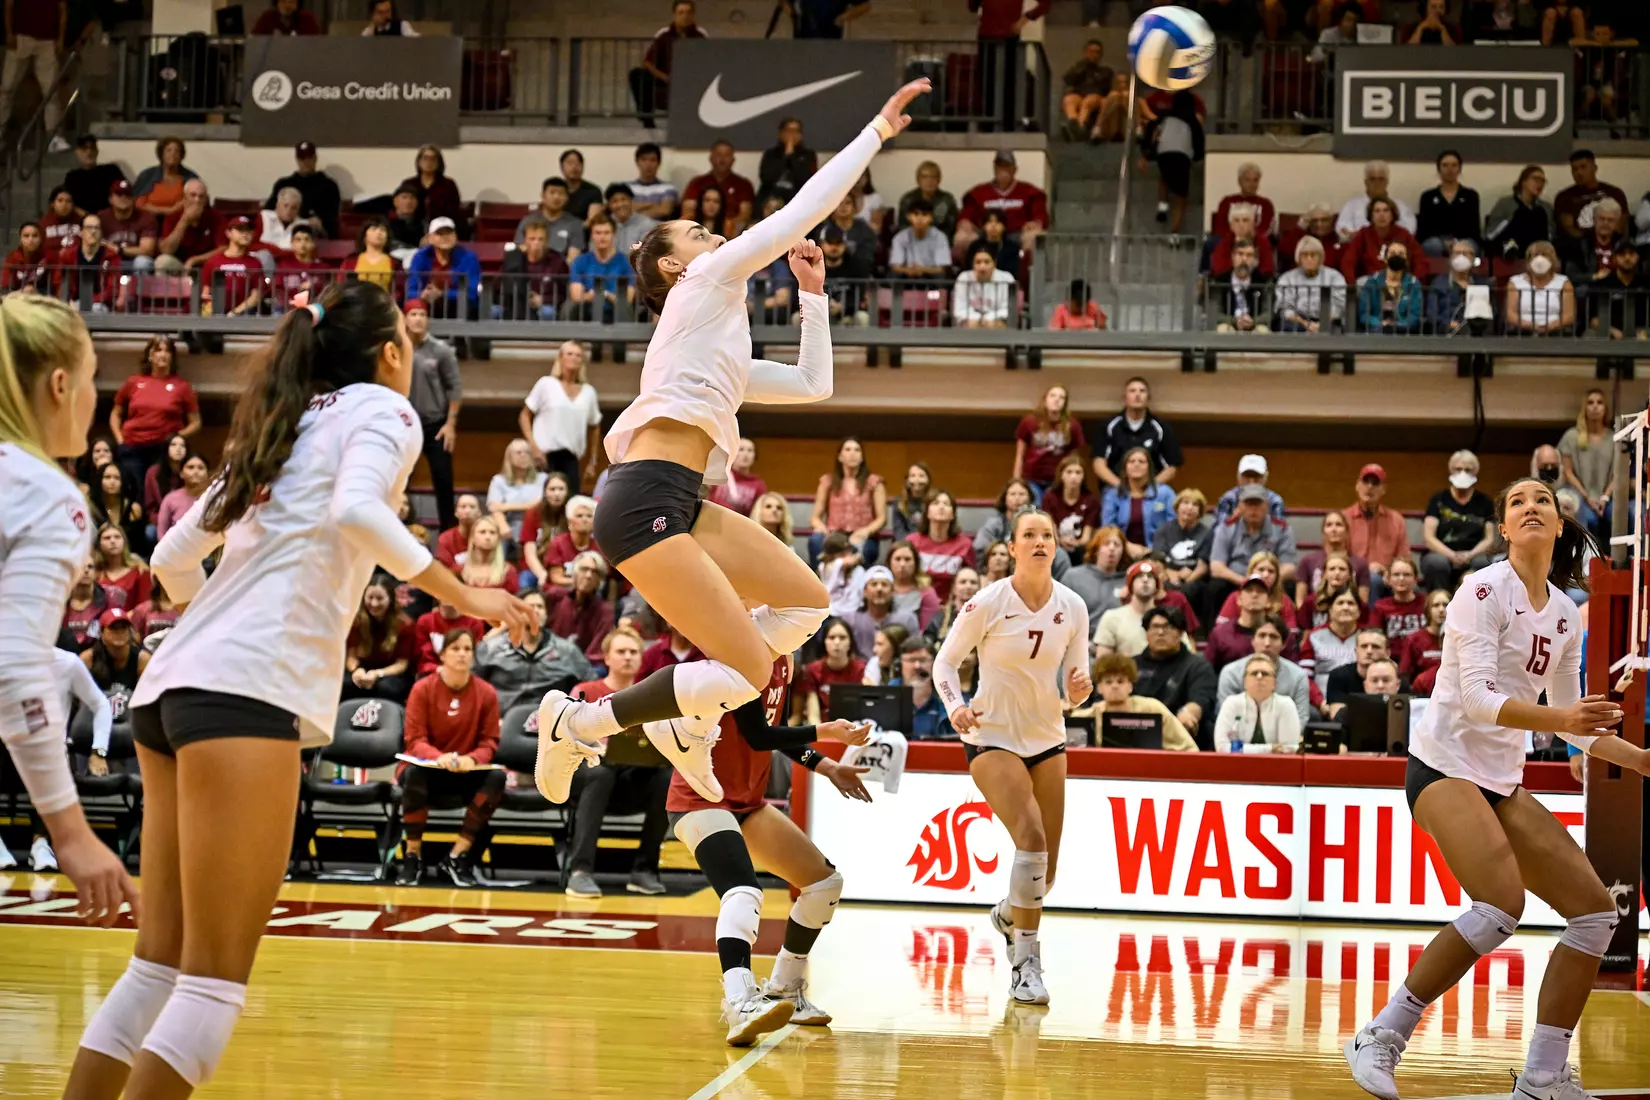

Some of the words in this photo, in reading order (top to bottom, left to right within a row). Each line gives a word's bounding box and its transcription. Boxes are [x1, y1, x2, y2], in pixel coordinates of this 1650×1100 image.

[296, 81, 341, 100] Gesa
[344, 81, 400, 100] Credit
[402, 81, 452, 101] Union
[1028, 630, 1044, 659] 7
[1525, 633, 1552, 676] 15
